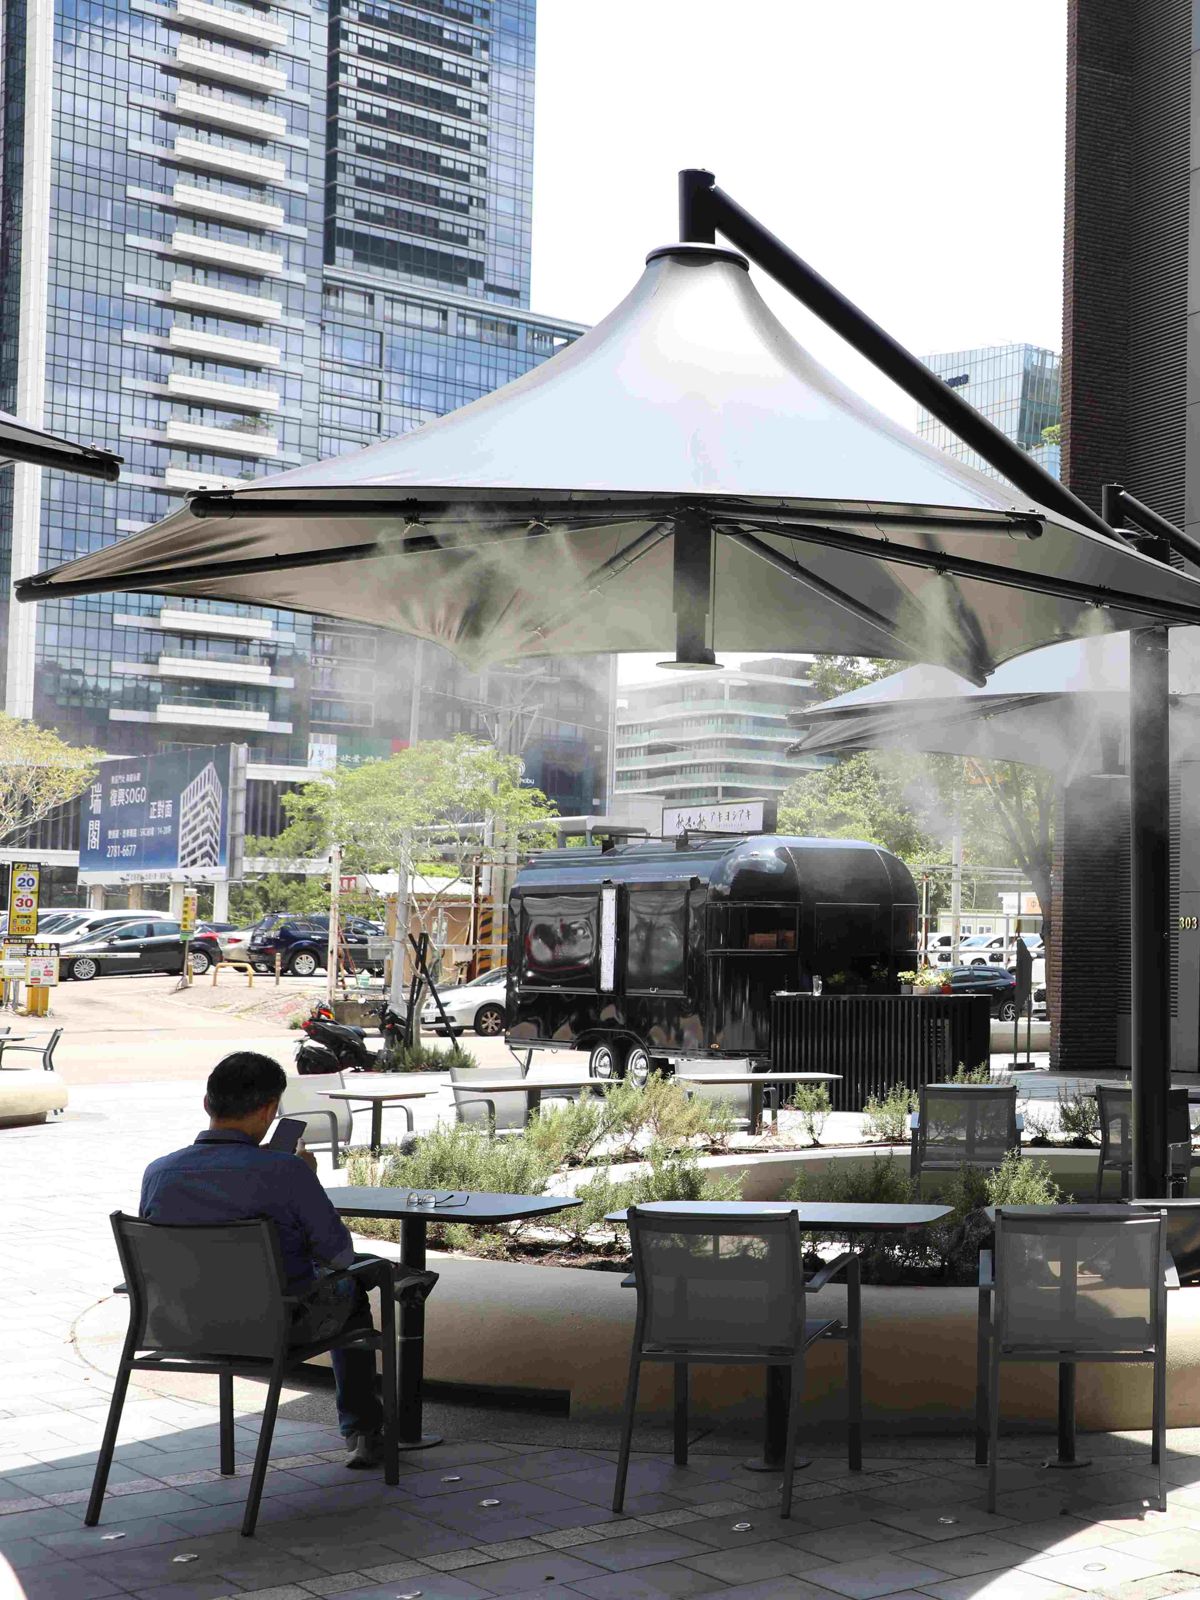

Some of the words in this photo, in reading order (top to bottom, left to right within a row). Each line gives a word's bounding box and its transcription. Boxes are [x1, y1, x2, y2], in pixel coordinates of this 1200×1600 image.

[110, 787, 147, 807] 復興SOGO
[88, 783, 102, 850] 瑞閣
[149, 800, 173, 819] 正對面
[17, 878, 35, 887] 20
[15, 898, 33, 907] 30
[1179, 917, 1197, 929] 303
